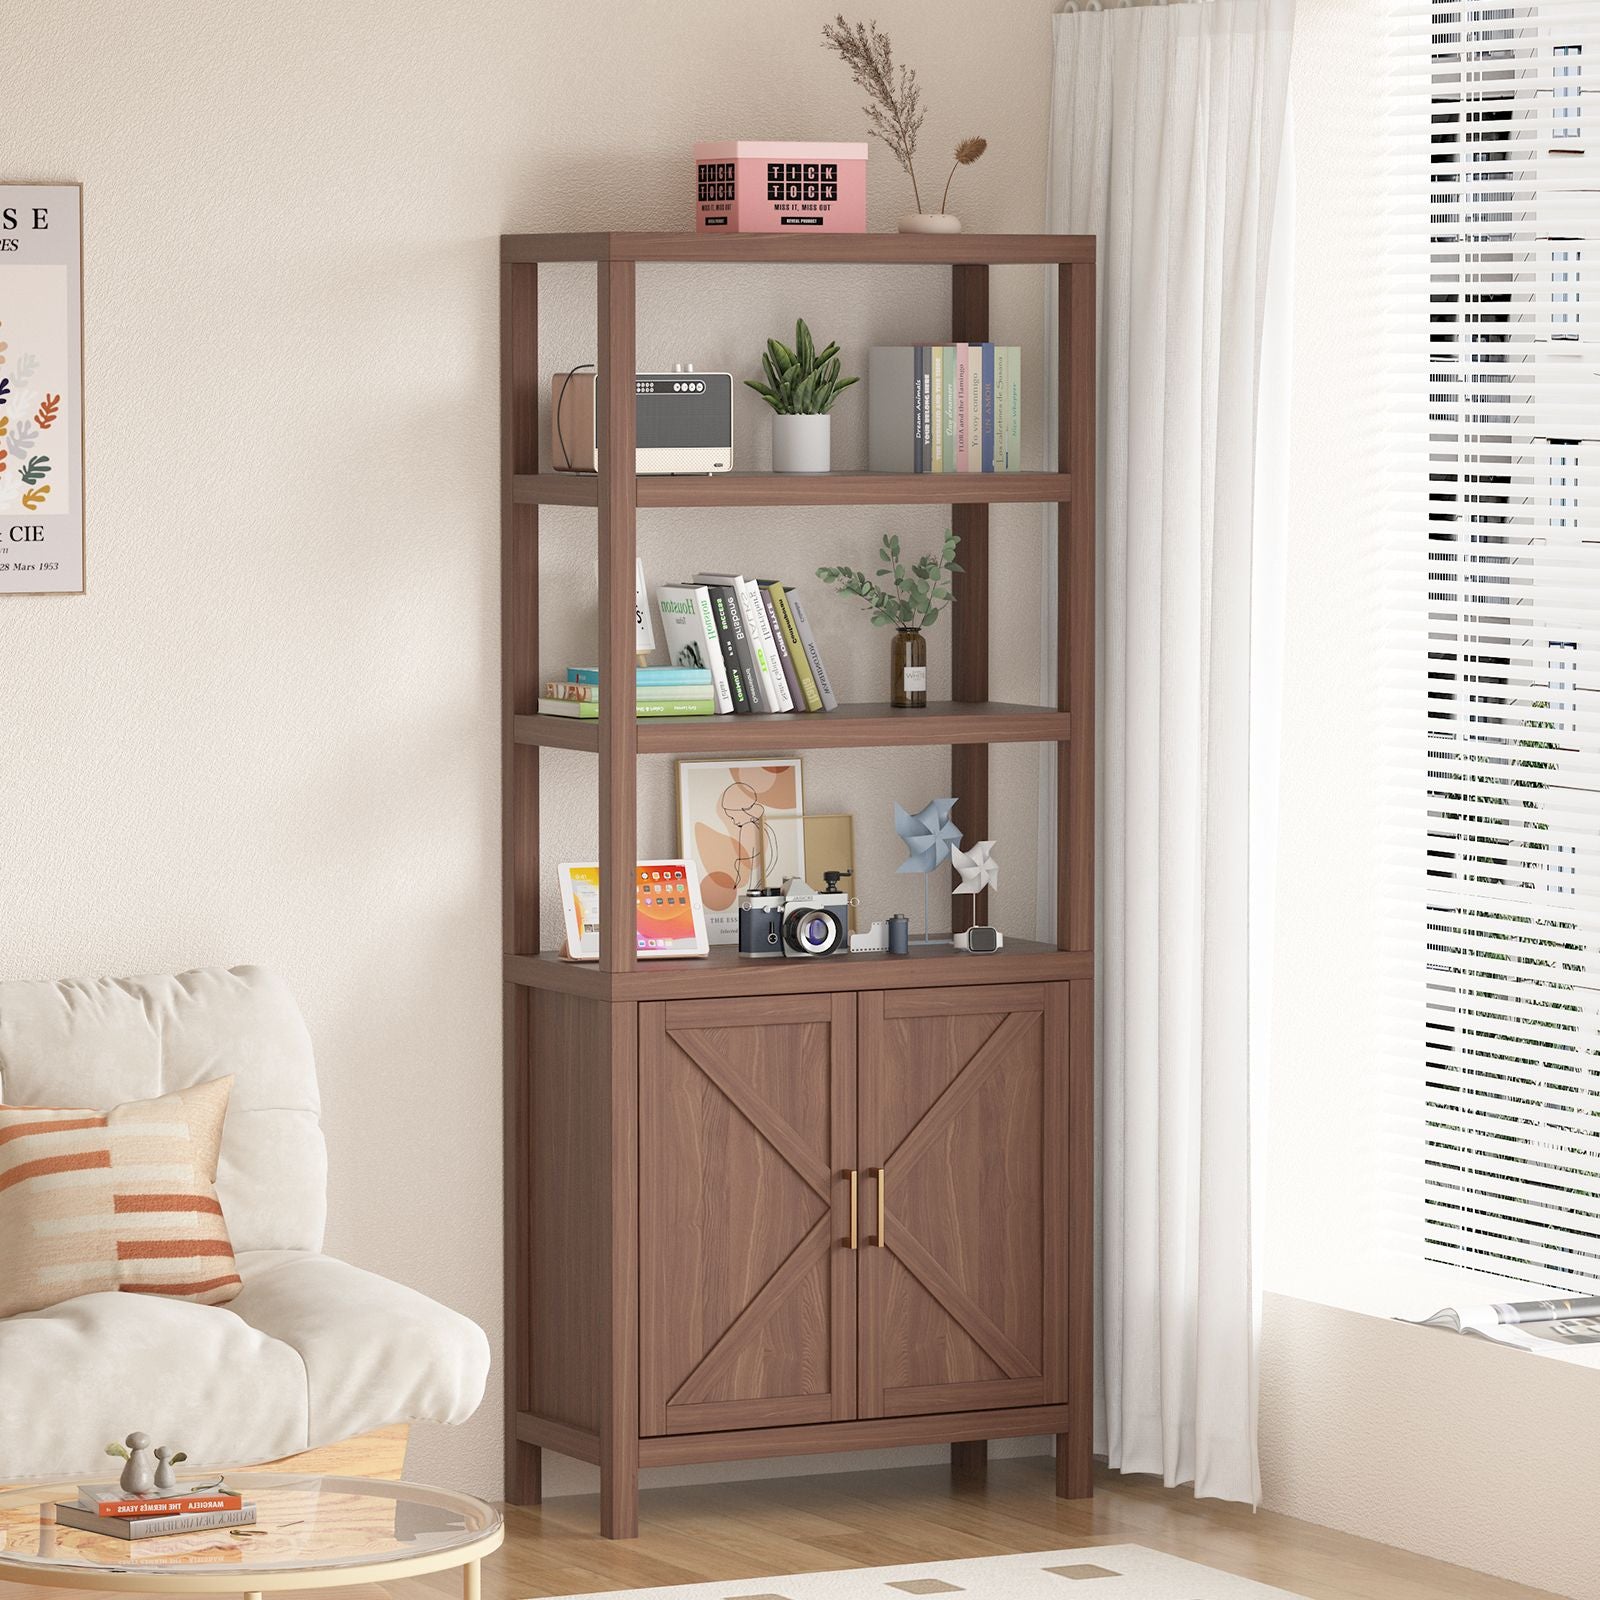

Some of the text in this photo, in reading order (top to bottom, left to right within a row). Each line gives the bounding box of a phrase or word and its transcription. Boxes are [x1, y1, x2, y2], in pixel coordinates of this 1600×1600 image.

[699, 165, 734, 181] TICK
[770, 165, 834, 180] TICK
[699, 184, 734, 200] TOCK
[770, 184, 834, 199] TOCK
[0, 238, 19, 252] ES
[958, 364, 966, 398] Flamingo
[972, 373, 980, 448] Yo voy conmigo
[10, 525, 44, 542] CIE
[13, 562, 36, 571] Mars
[39, 562, 59, 570] 1953
